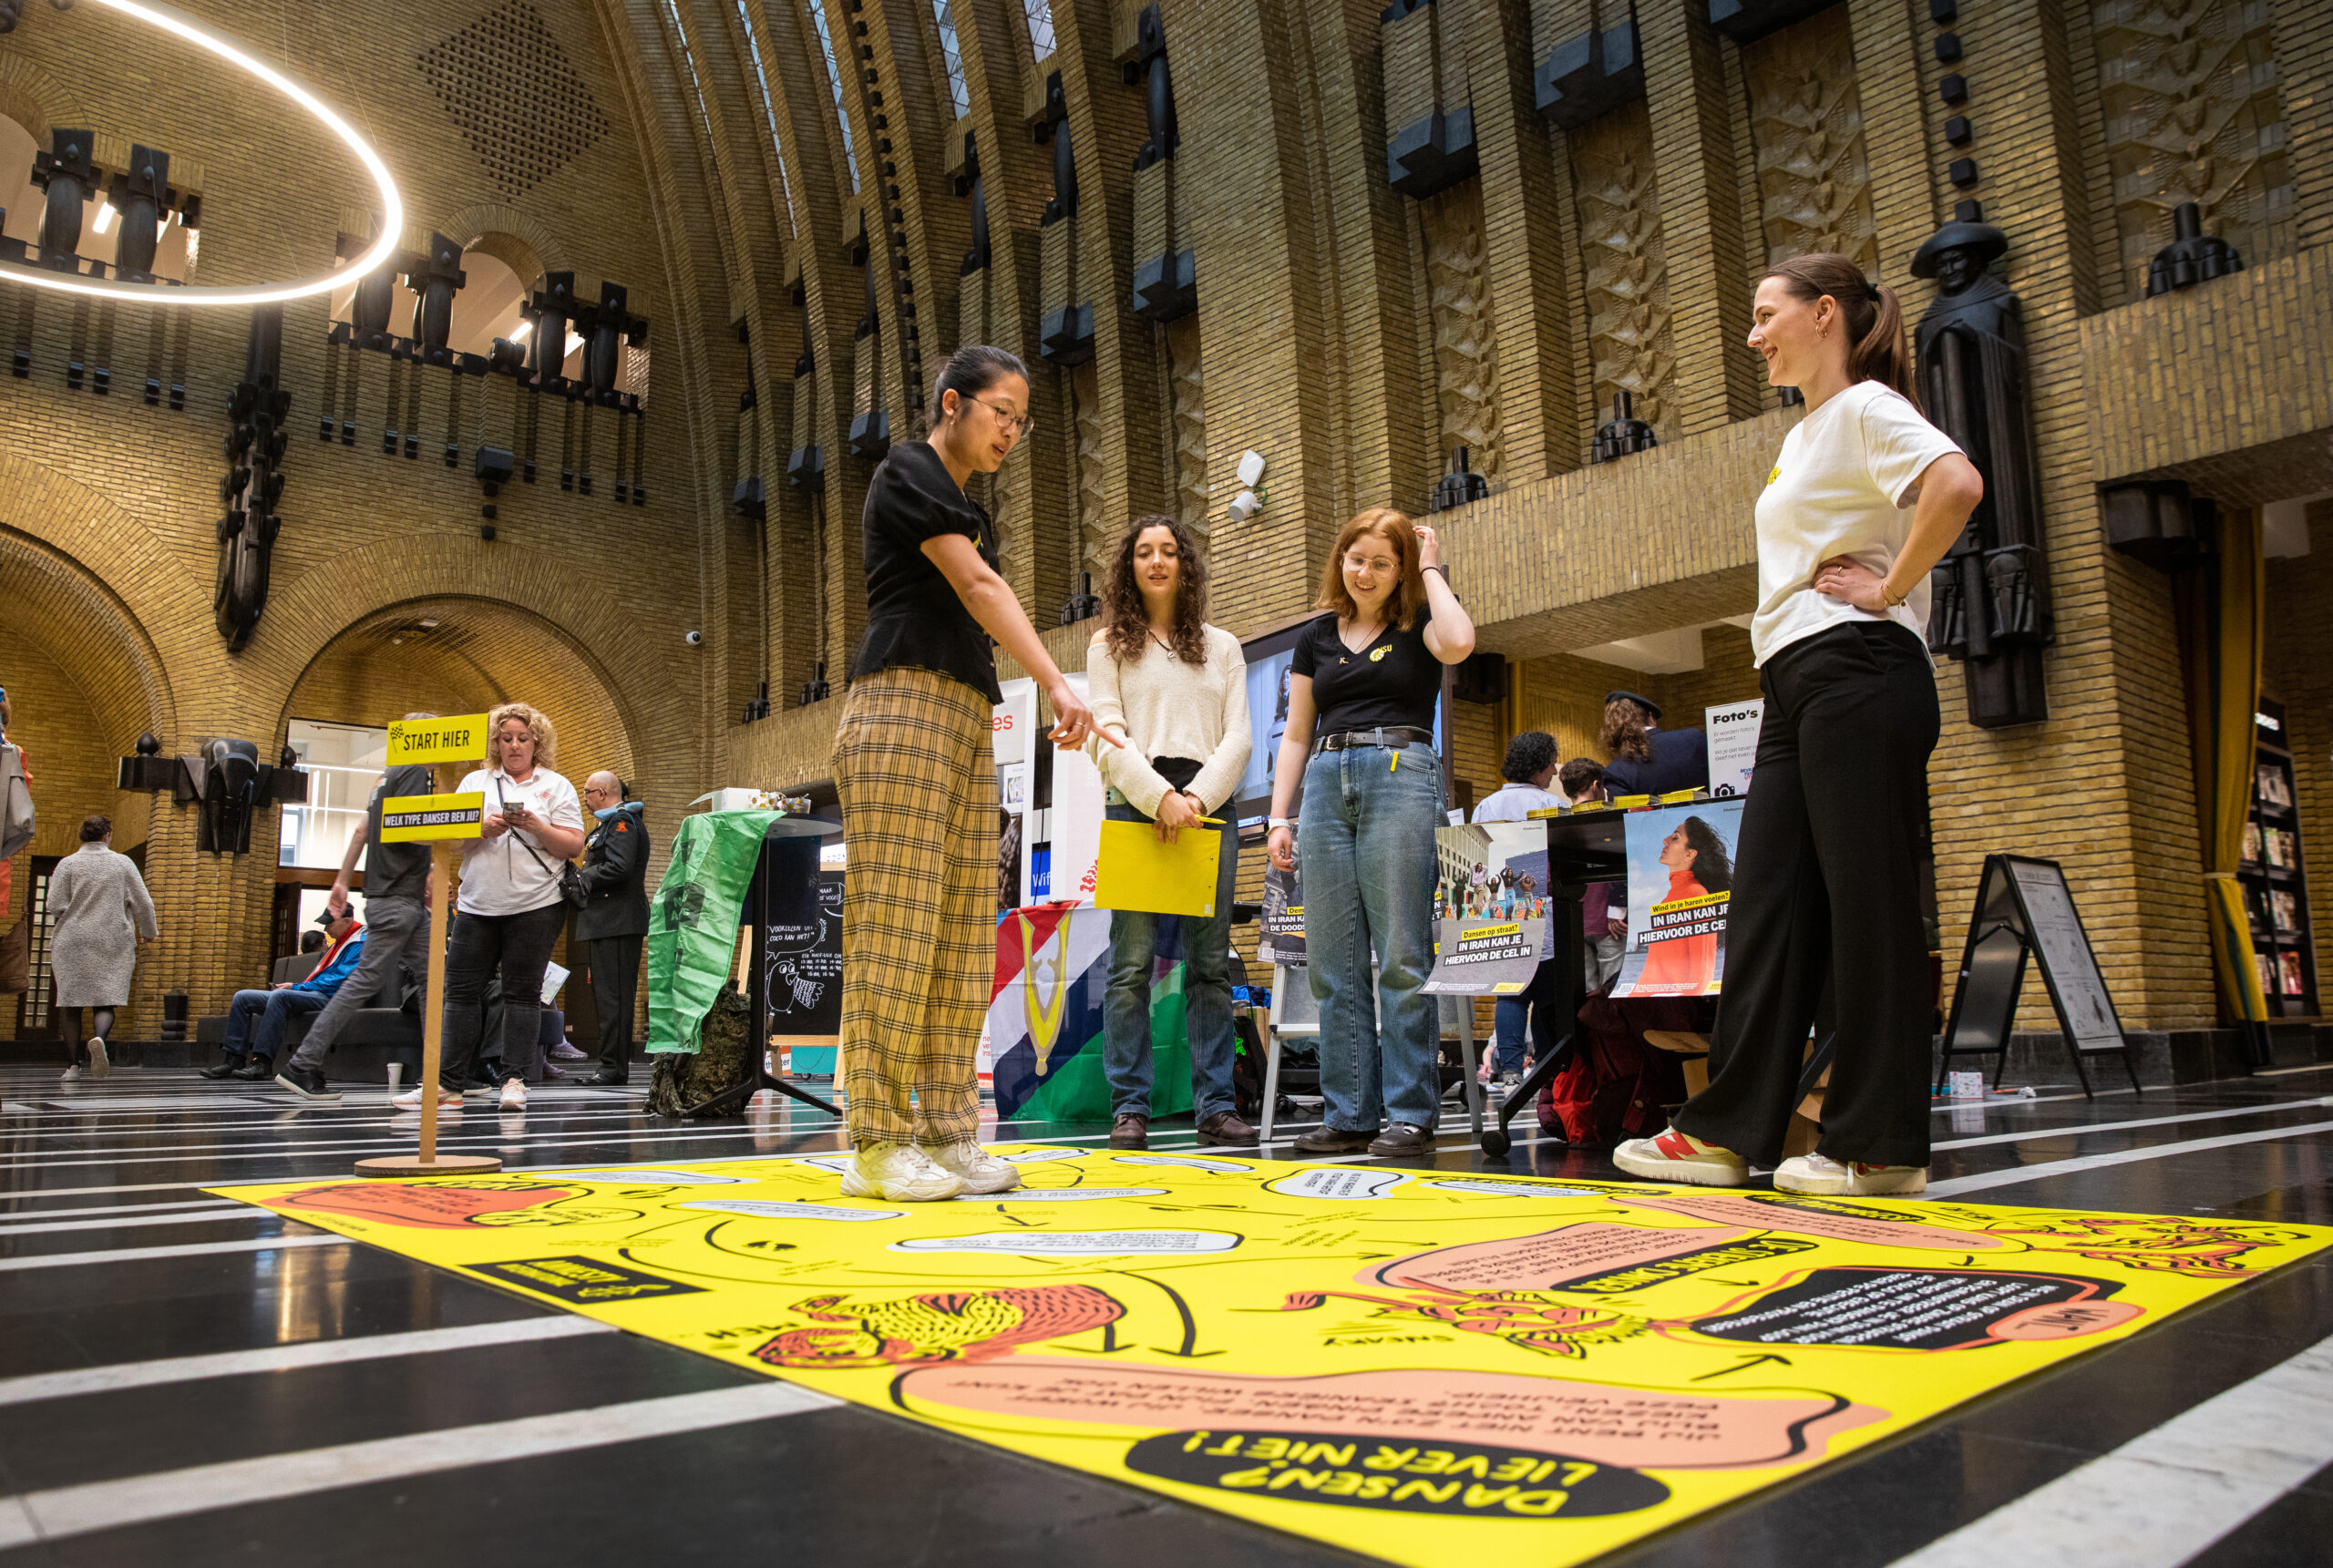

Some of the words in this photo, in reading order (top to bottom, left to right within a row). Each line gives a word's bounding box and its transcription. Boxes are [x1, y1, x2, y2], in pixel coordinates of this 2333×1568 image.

[1713, 710, 1758, 724] Foto's
[404, 733, 438, 751] START
[442, 730, 469, 747] HIER
[384, 814, 404, 826] WELK
[404, 813, 422, 825] TYPE
[422, 812, 450, 825] DANSER
[451, 810, 465, 823] BEN
[1652, 904, 1669, 913] Wind
[1670, 902, 1677, 910] in
[1678, 901, 1684, 910] je
[1685, 898, 1703, 908] haren
[1704, 893, 1730, 905] voelen?
[1653, 915, 1665, 927] IN
[1666, 911, 1692, 926] IRAN
[1693, 907, 1717, 921] KAN
[1464, 930, 1486, 938] Dansen
[1496, 925, 1518, 934] straat?
[1639, 925, 1693, 944] HIERVOOR
[1694, 922, 1709, 934] DE
[1458, 942, 1468, 951] IN
[1469, 940, 1490, 950] IRAN
[1491, 938, 1510, 948] KAN
[1510, 935, 1522, 945] JE
[1444, 953, 1488, 966] HIERVOOR
[1489, 950, 1502, 959] DE
[1503, 948, 1519, 958] CEL
[1520, 947, 1531, 957] IN
[1748, 1238, 1814, 1253] DE
[1567, 1265, 1671, 1293] DANSER
[945, 1379, 1031, 1390] KUNT
[1054, 1377, 1120, 1387] OOK
[1126, 1381, 1243, 1394] WILLEN
[1093, 1389, 1151, 1399] DAT
[1623, 1399, 1720, 1410] DEZE
[1397, 1408, 1542, 1421] ANDERE
[1552, 1416, 1624, 1427] VAN
[1458, 1421, 1534, 1432] NIET
[1547, 1426, 1646, 1439] BENT
[1183, 1430, 1358, 1468] NIET!
[1363, 1445, 1598, 1487] LIEVER
[1219, 1459, 1569, 1516] DANSEN?
